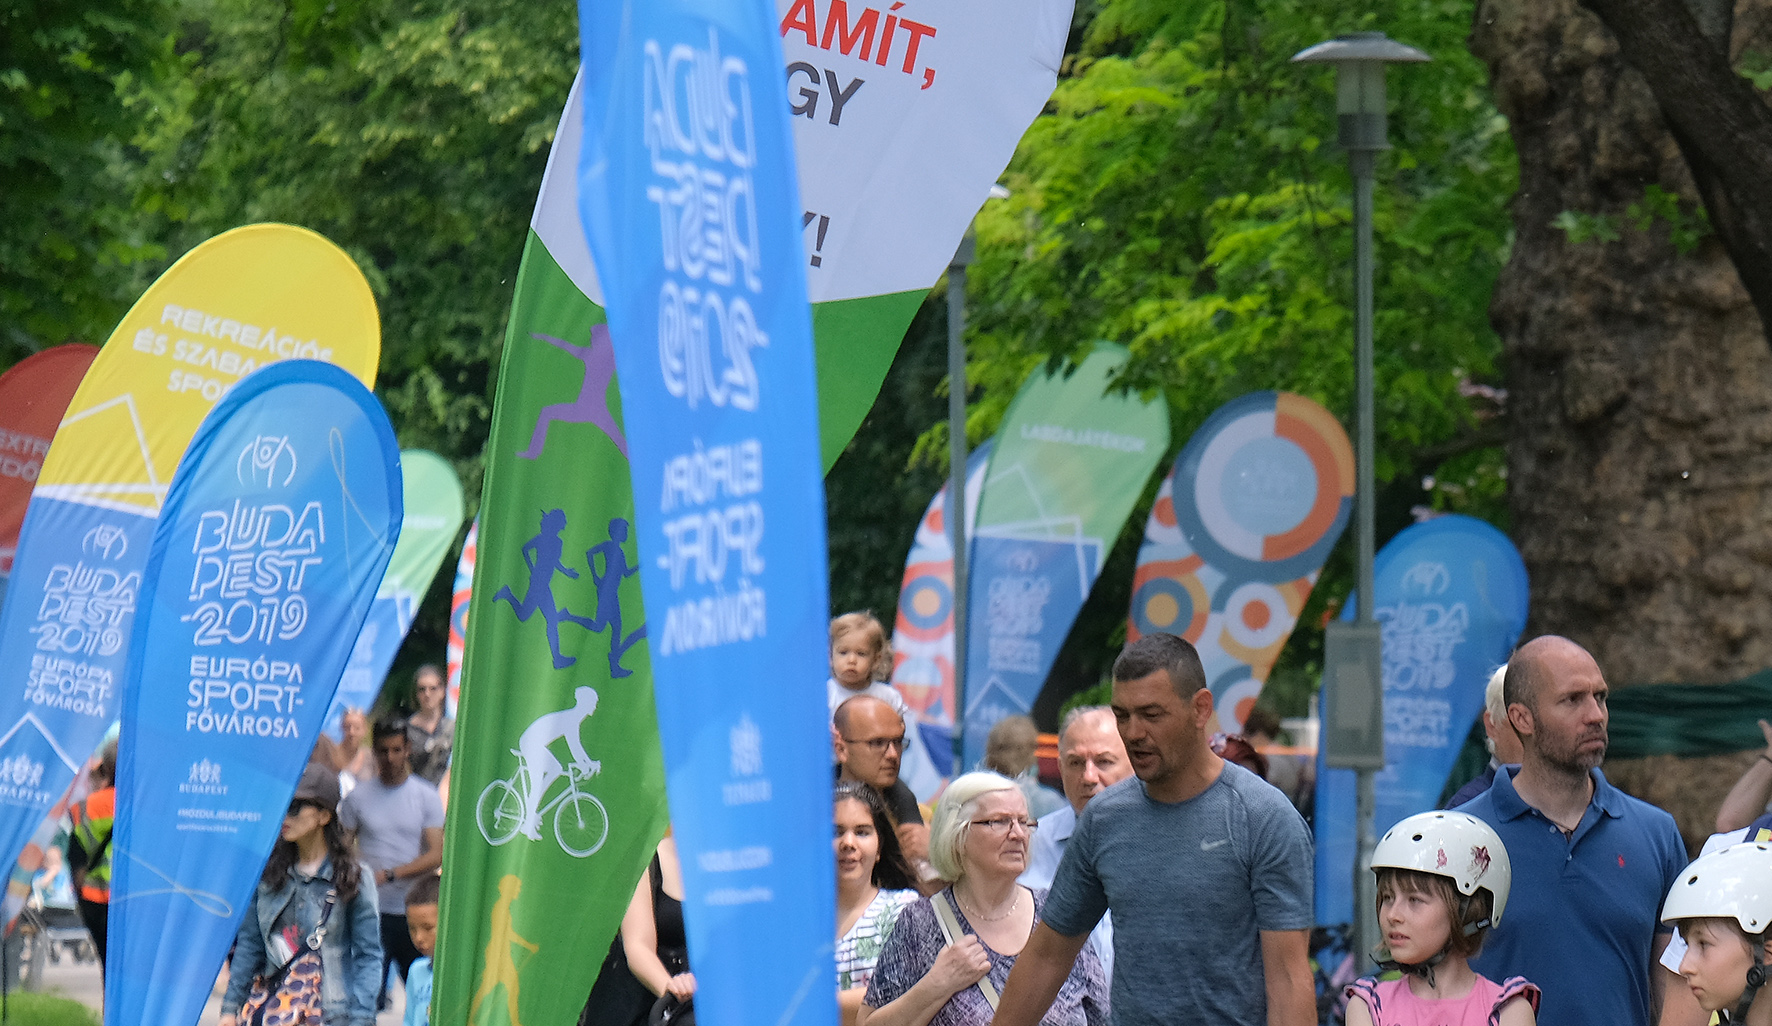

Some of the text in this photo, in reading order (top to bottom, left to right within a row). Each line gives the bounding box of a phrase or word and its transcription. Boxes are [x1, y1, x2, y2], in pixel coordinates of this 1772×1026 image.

[133, 326, 262, 377] ÉS SZABA
[167, 369, 230, 401] SPO
[192, 498, 325, 553] BUDA
[43, 560, 141, 602] BUDA
[188, 548, 323, 600] PEST
[37, 591, 135, 627] PEST
[180, 593, 308, 646] 2019
[29, 621, 123, 656] 2019
[26, 668, 112, 702] SPORT-
[31, 653, 113, 684] EURÓPA
[190, 654, 303, 684] EURÓPA
[23, 687, 105, 719] FŐVÁROSA
[187, 678, 304, 714] SPORT-
[186, 706, 300, 739] FŐVÁROSA
